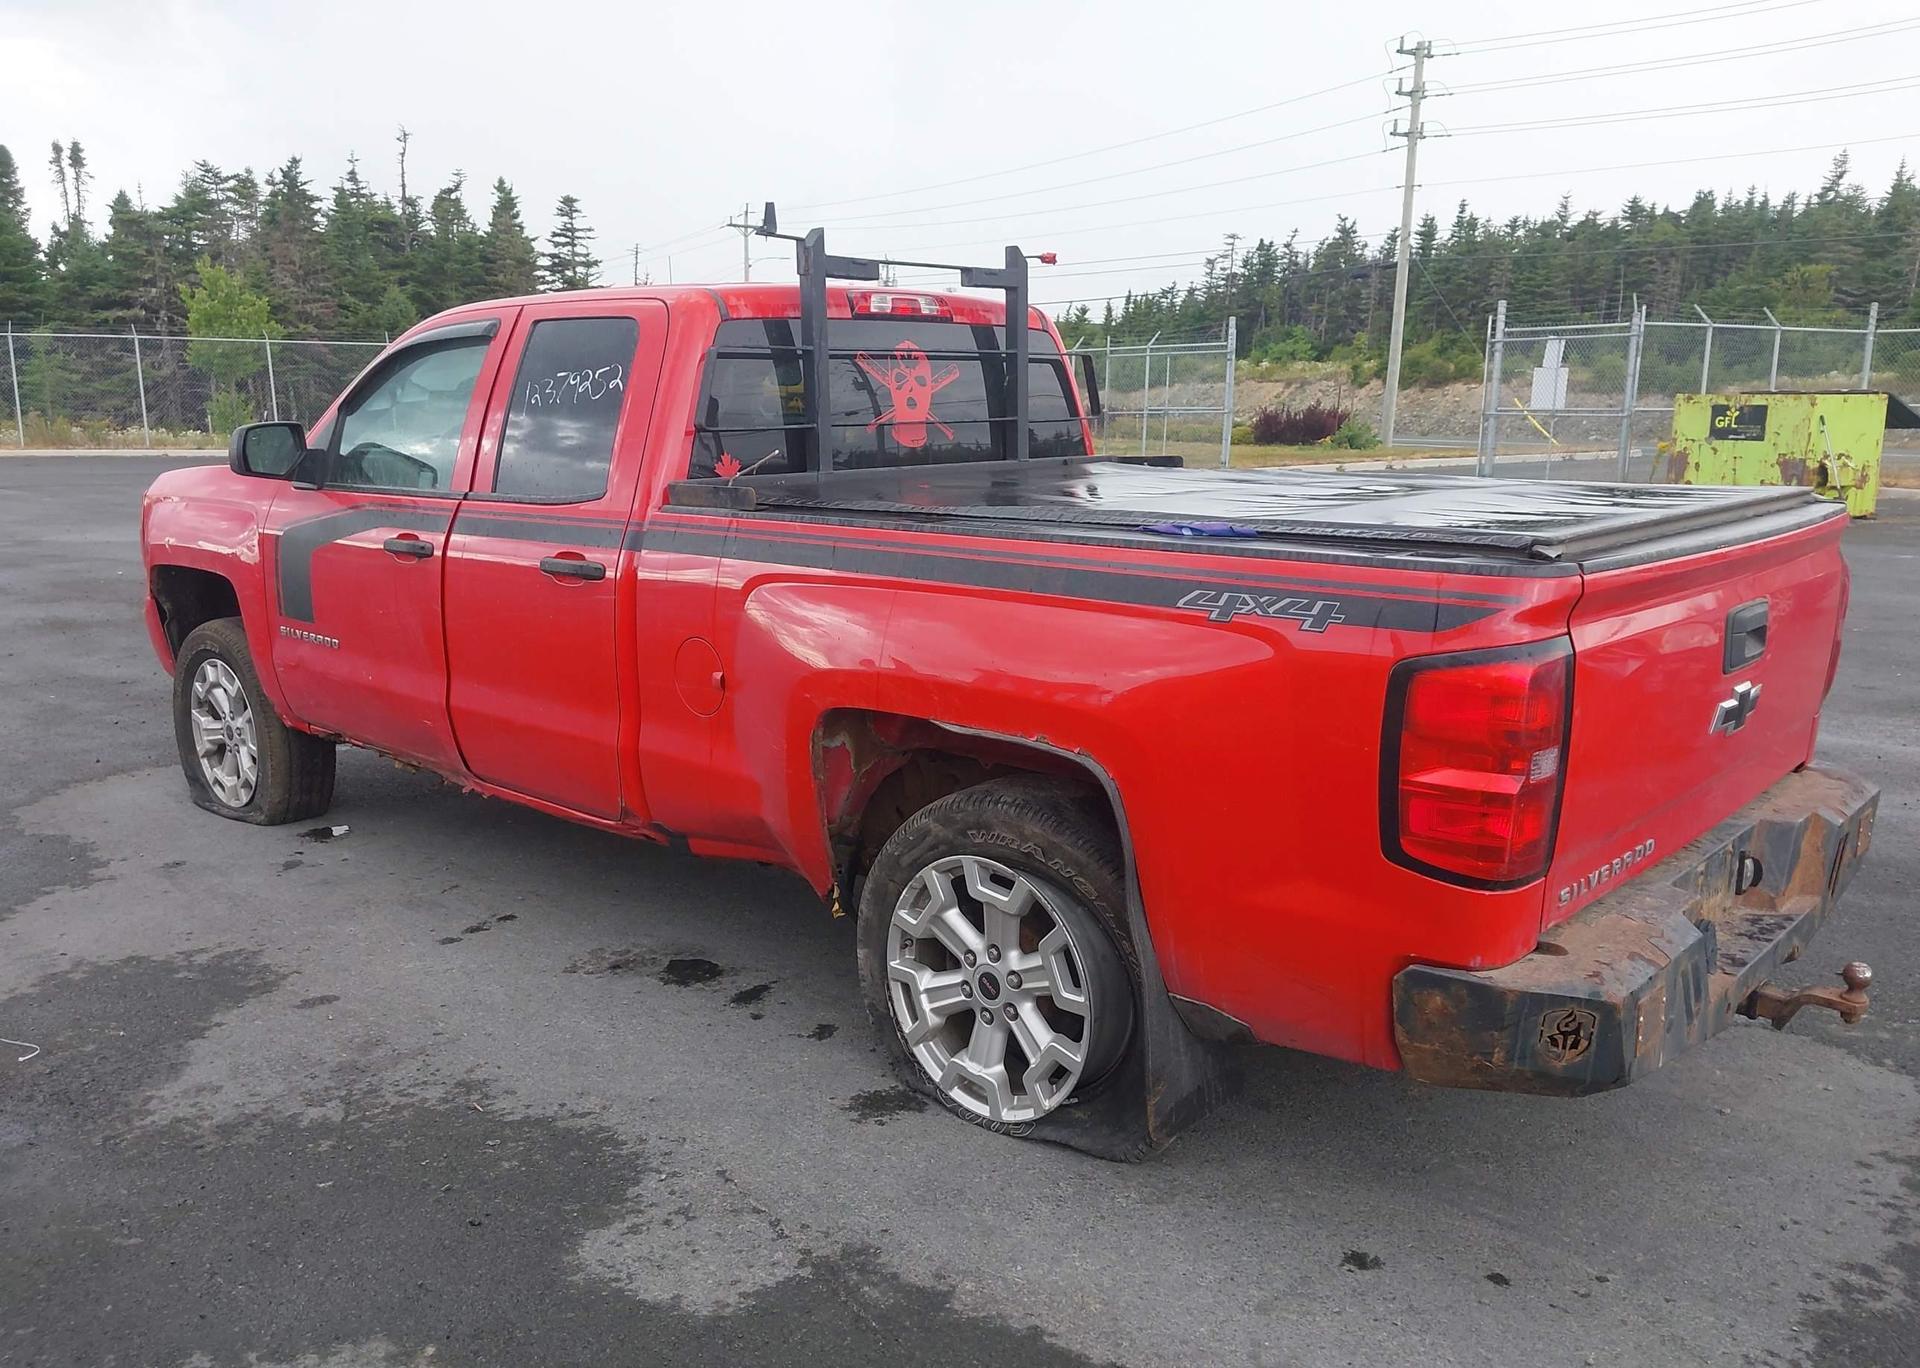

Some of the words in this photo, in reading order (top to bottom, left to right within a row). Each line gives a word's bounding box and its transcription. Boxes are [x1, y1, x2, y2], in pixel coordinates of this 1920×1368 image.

[523, 363, 623, 417] 12379252
[1715, 411, 1739, 428] GFL
[280, 625, 340, 649] SILVERADO
[1557, 838, 1655, 908] SILVERADO
